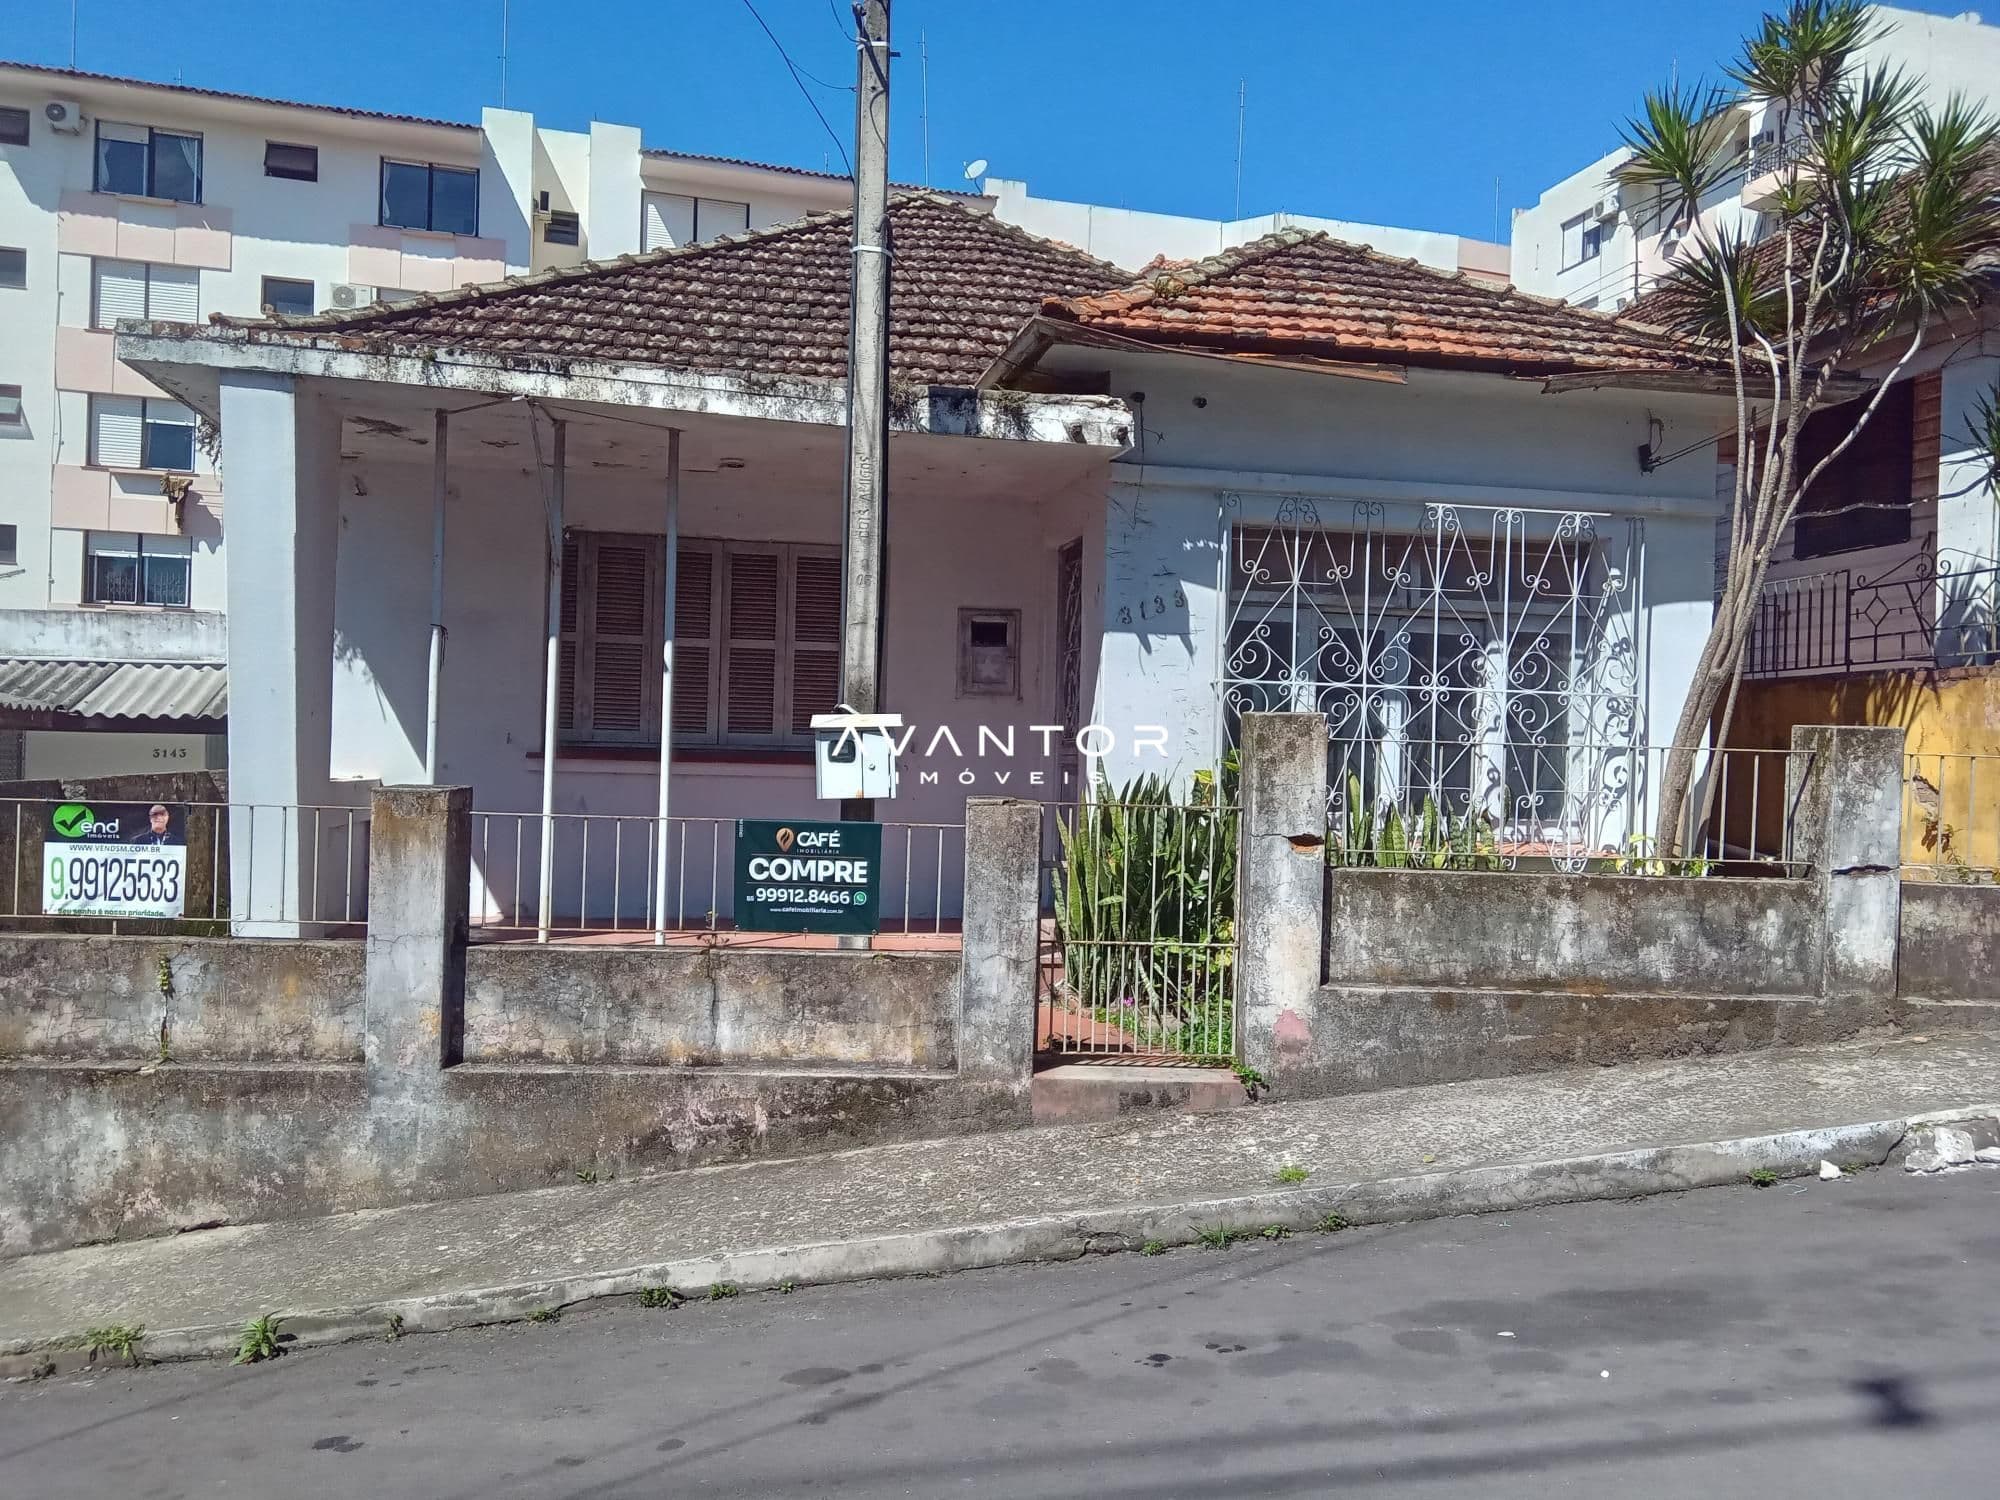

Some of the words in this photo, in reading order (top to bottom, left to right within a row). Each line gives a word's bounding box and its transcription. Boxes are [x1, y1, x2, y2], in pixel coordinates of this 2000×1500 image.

[152, 748, 187, 759] 3143
[796, 830, 841, 848] CAFÉ
[69, 844, 161, 854] WWW.VENDSM.COM.BR
[748, 857, 868, 883] COMPRE
[51, 857, 180, 902] 9.99125533
[756, 888, 850, 904] 99912.8466
